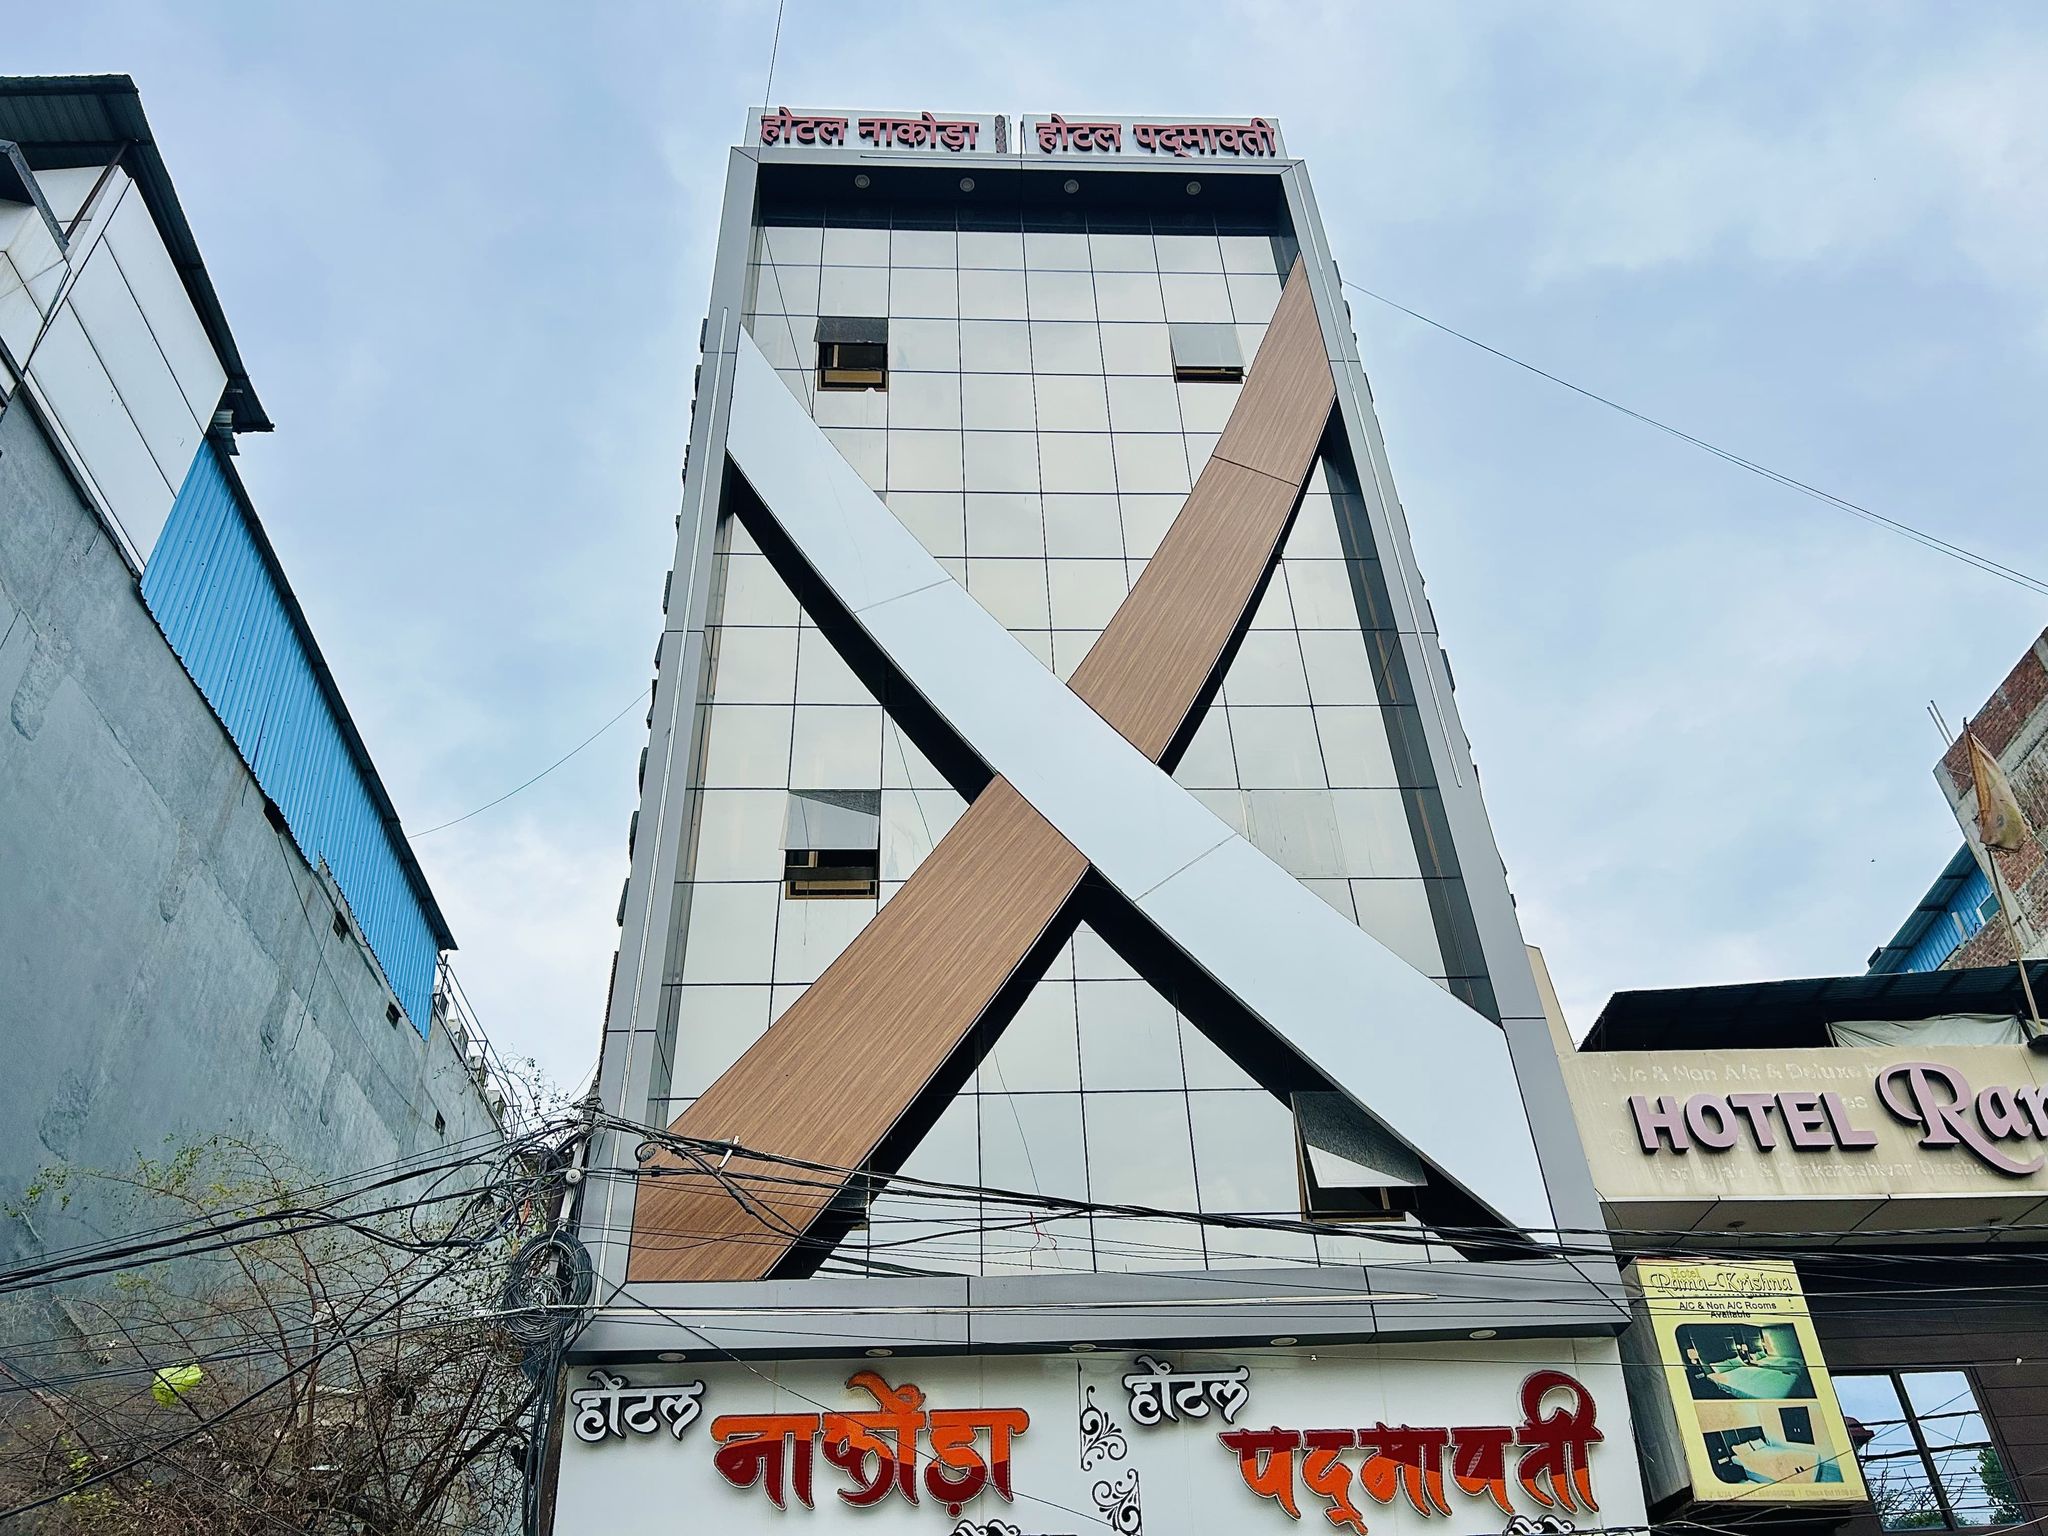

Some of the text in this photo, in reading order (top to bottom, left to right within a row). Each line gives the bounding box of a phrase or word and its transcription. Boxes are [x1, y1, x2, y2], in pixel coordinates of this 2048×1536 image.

[761, 106, 980, 152] होटल नाकोड़ा
[1036, 113, 1277, 157] होटल पद्मावती
[1629, 1092, 1879, 1155] HOTEL
[1669, 1268, 1700, 1279] Hotel
[1679, 1301, 1777, 1310] A/C & Non A/C Rooms
[573, 1369, 706, 1443] होटल
[1122, 1354, 1253, 1426] होटल
